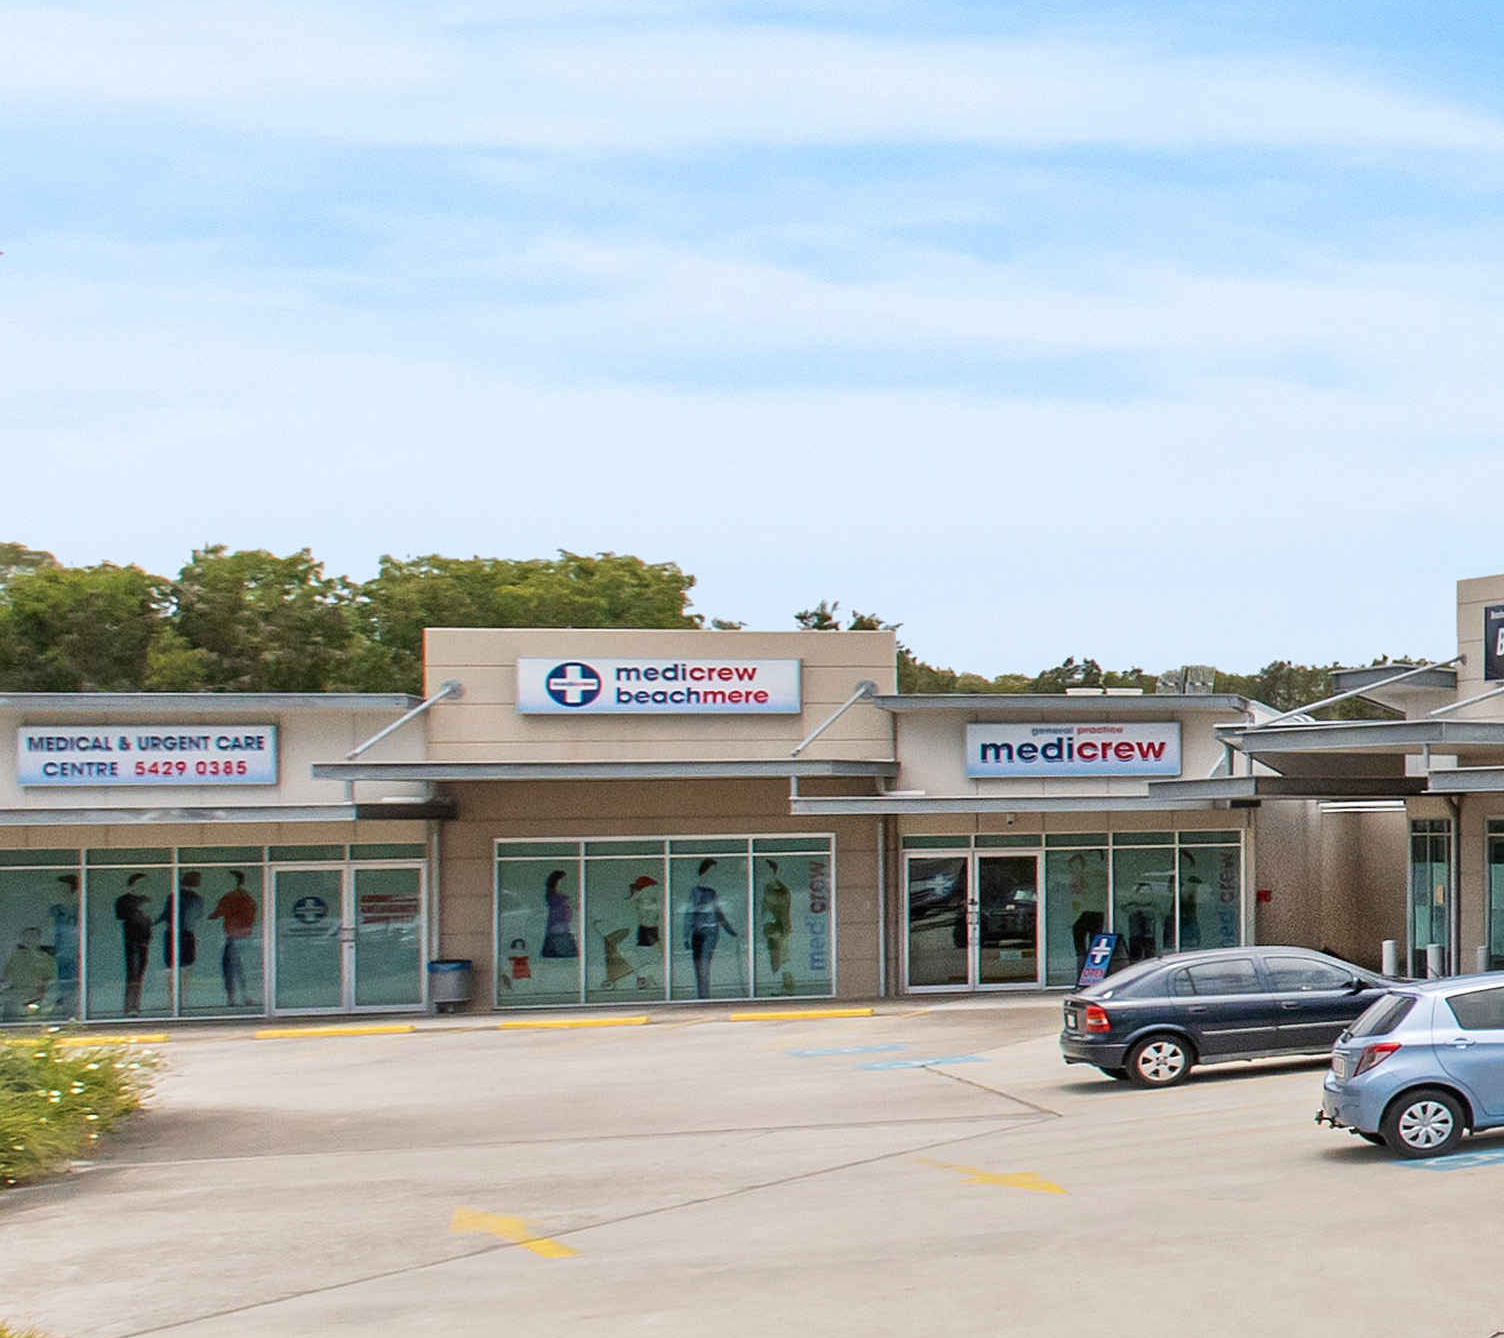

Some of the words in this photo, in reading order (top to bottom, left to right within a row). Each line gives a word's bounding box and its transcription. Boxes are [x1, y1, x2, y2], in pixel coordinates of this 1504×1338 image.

[616, 663, 757, 681] medicrew
[616, 687, 769, 704] beachmere
[27, 736, 112, 752] MEDICAL
[118, 736, 131, 751] &
[137, 736, 209, 751] URGENT
[215, 735, 265, 750] CARE
[980, 737, 1166, 762] medicrew
[43, 762, 118, 777] CENTRE
[135, 761, 187, 776] 5429
[195, 760, 247, 776] 0385
